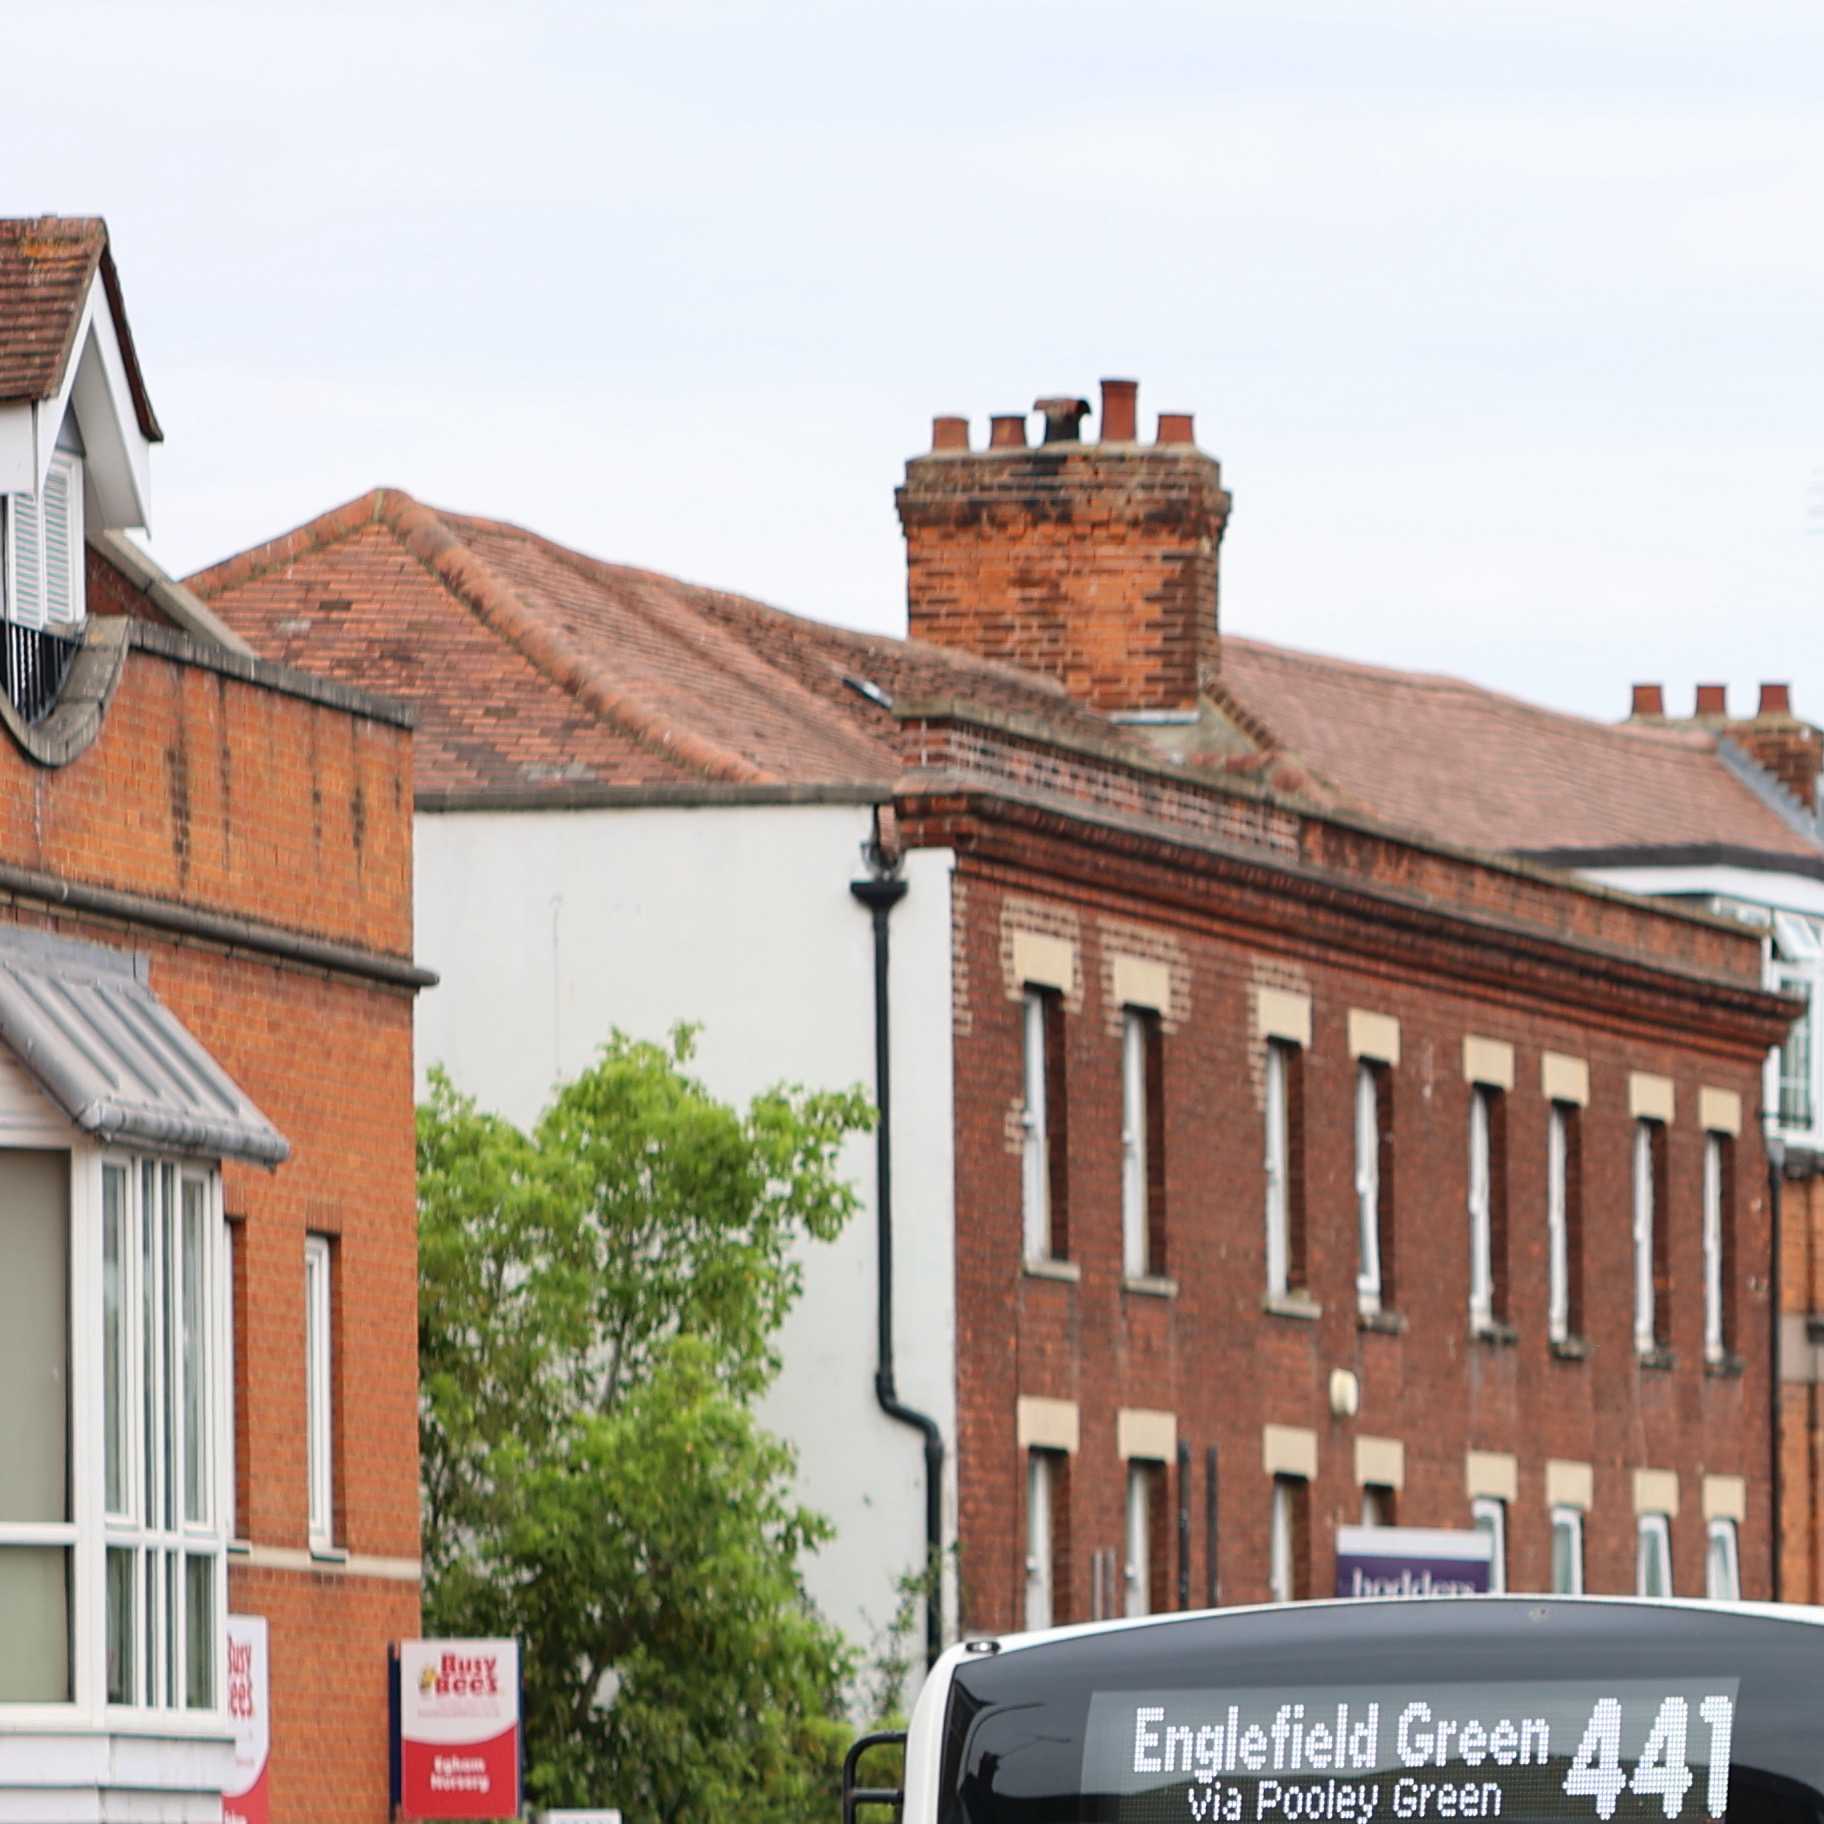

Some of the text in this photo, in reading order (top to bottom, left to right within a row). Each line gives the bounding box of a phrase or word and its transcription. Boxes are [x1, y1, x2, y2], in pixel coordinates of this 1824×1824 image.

[441, 1652, 497, 1675] Busy
[434, 1675, 498, 1697] Bees
[433, 1756, 486, 1774] Egham
[1133, 1695, 1733, 1819] Englefield Green 441
[1187, 1777, 1502, 1824] via Pooley Green
